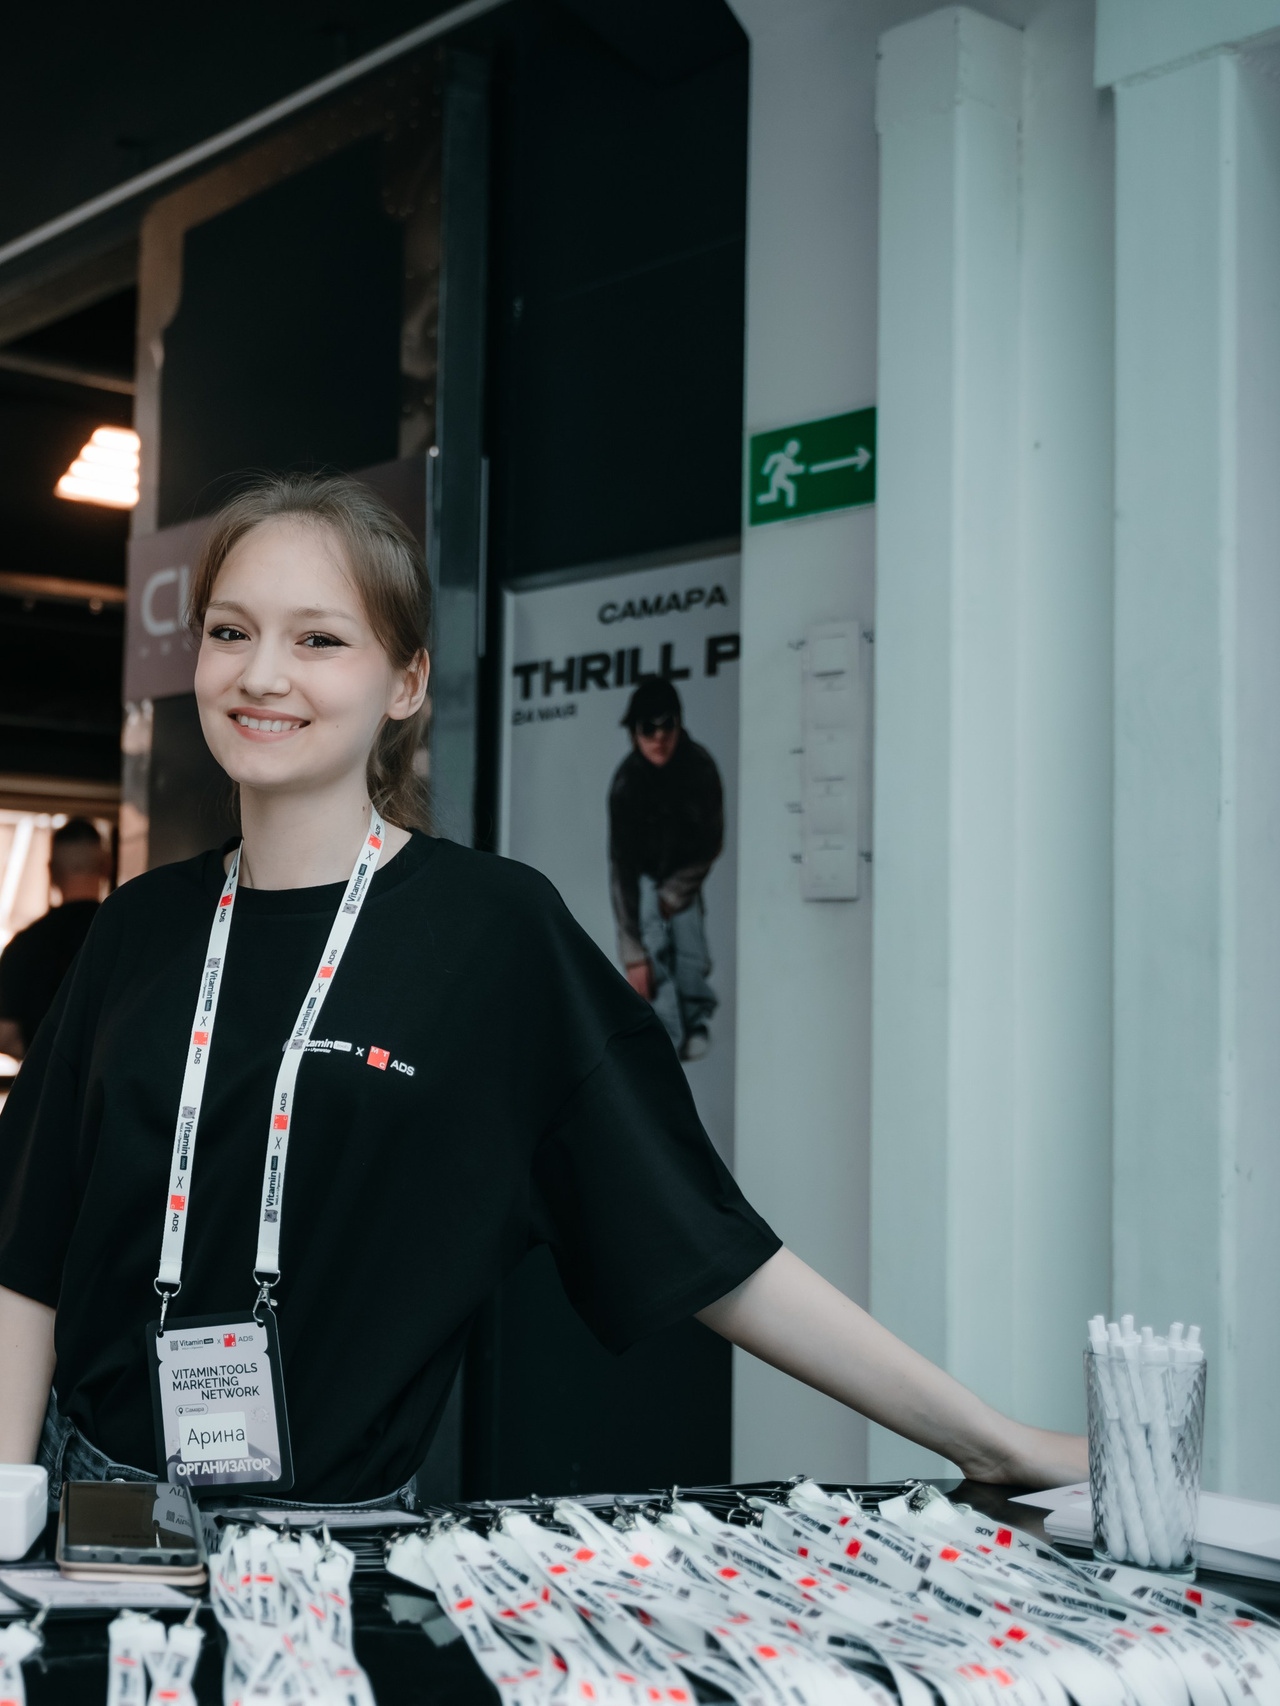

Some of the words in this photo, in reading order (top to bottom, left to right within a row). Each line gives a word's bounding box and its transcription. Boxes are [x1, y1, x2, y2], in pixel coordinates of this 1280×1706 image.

[597, 585, 728, 624] САМАРА
[513, 642, 691, 700] THRILL
[348, 875, 363, 902] Vitamin
[207, 970, 218, 1000] Vitamin
[295, 1009, 312, 1038] Vitamin
[328, 949, 337, 965] ADS
[194, 1047, 202, 1064] ADS
[390, 1060, 415, 1076] ADS
[181, 1121, 193, 1156] Vitamin
[265, 1171, 277, 1207] Vitamin
[180, 1338, 203, 1346] Vitamin
[172, 1363, 258, 1380] VITAMIN.TOOLS
[172, 1376, 239, 1391] MARKETING
[201, 1386, 260, 1400] NETWORK
[187, 1428, 245, 1449] Арина
[176, 1458, 271, 1476] ОРГАНИЗАТОР
